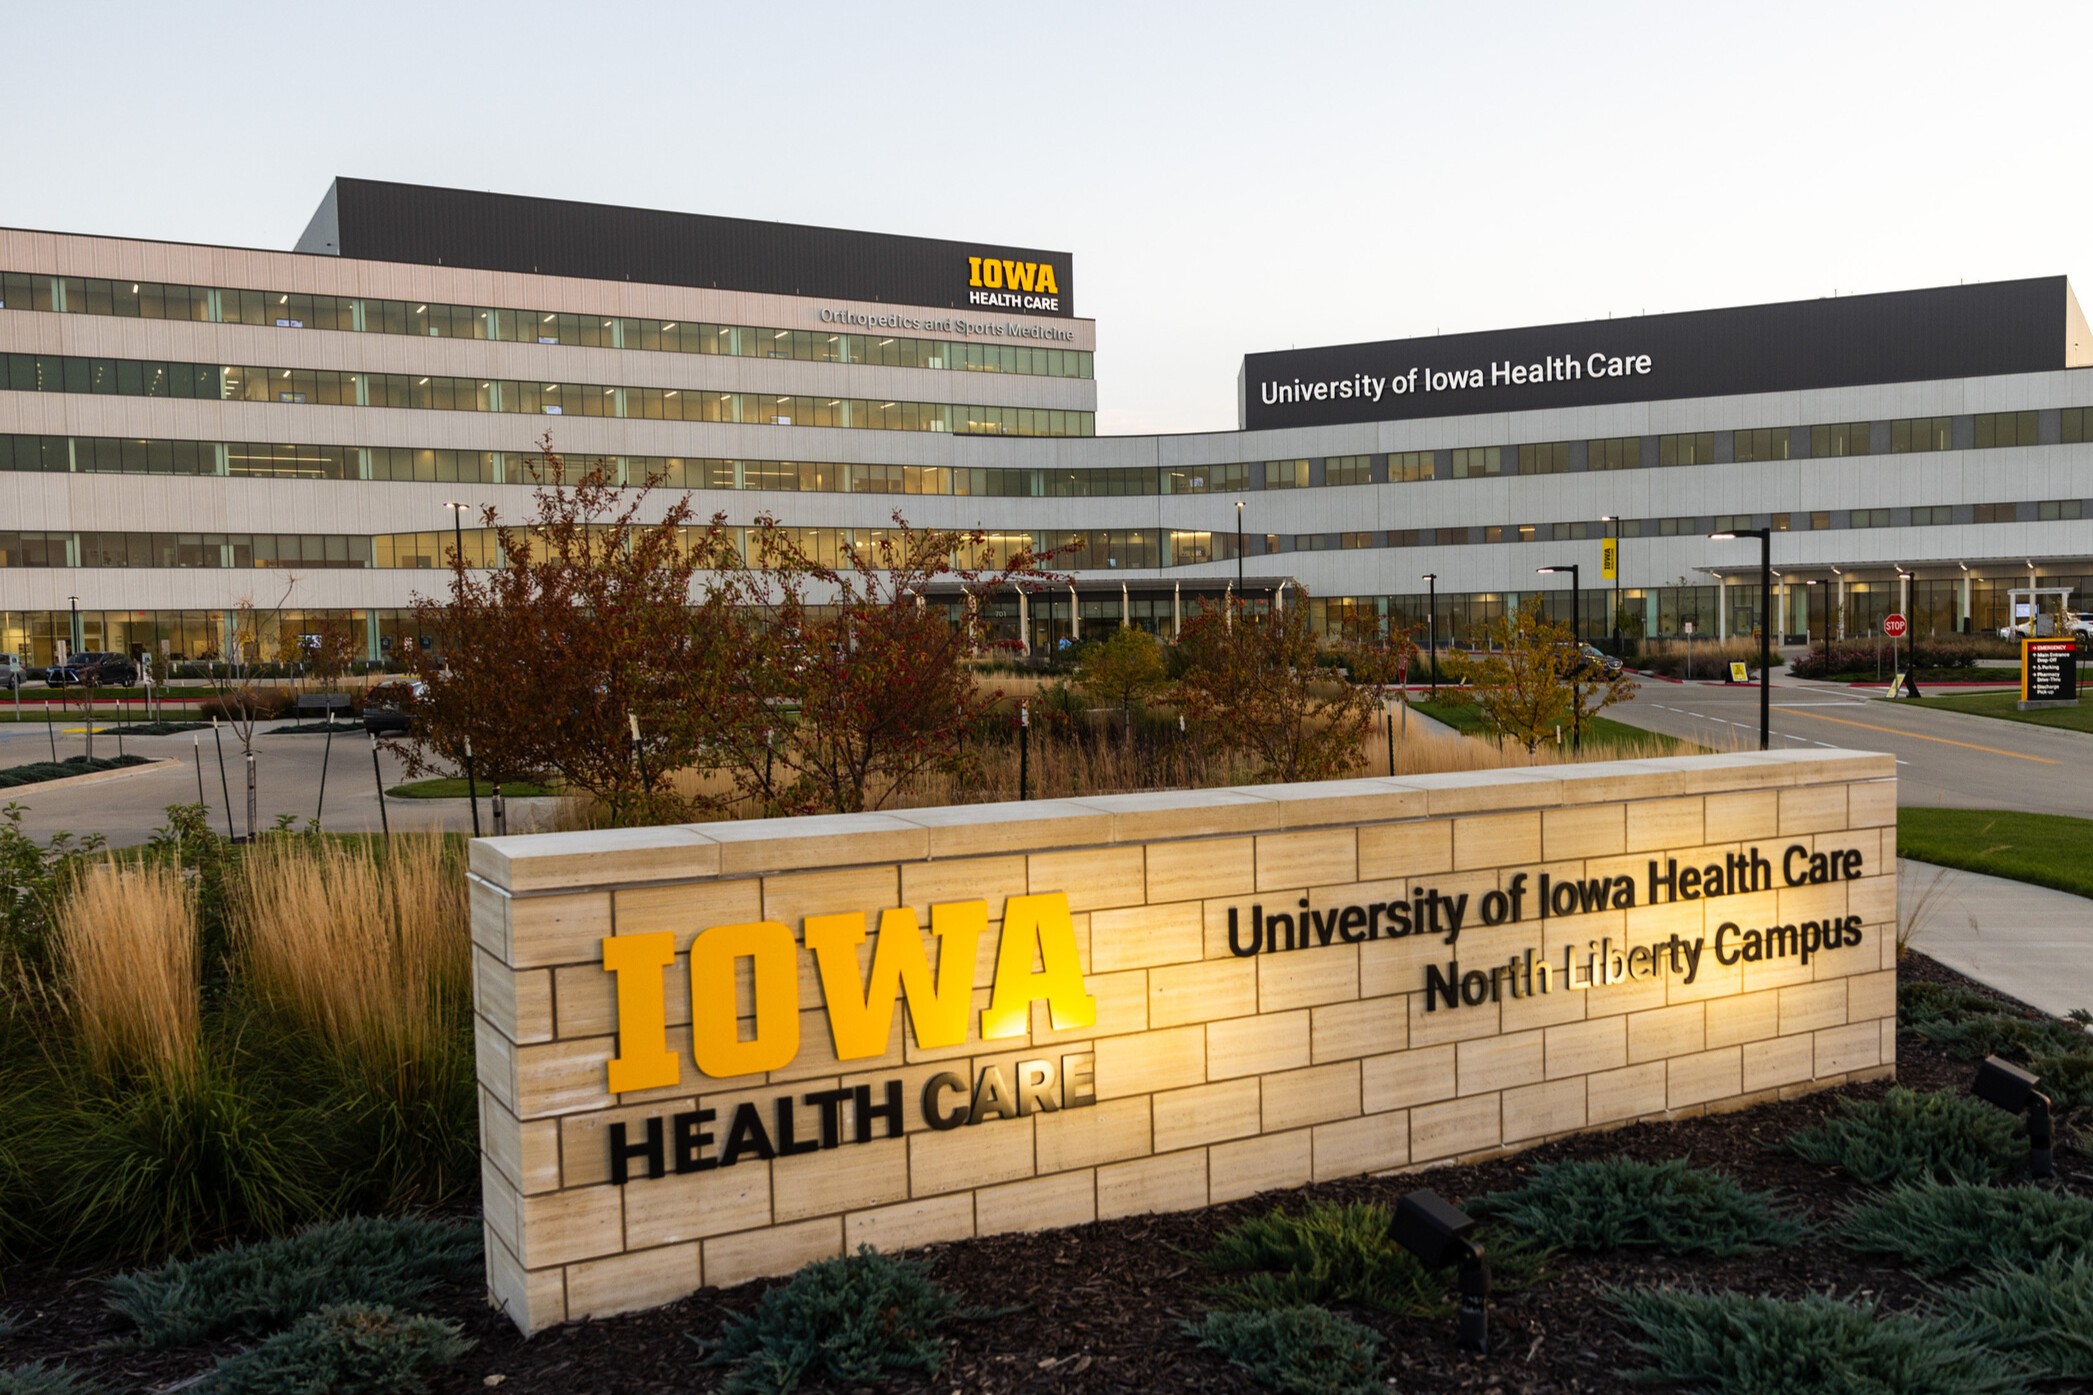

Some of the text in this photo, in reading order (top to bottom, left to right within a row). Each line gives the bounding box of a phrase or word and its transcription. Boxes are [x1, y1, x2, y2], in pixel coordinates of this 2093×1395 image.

[968, 256, 1059, 294] IOWA
[969, 291, 1059, 311] HEALTH CARE
[820, 307, 1075, 341] Orthopedics and Sports Medicine
[1261, 352, 1652, 404] University of Iowa Health Care
[1886, 621, 1905, 631] STOP
[1227, 844, 1863, 958] University of Iowa Health Care
[1425, 914, 1863, 1012] North Liberty Campus
[602, 890, 1096, 1094] IOWA
[608, 1050, 1097, 1185] HEALTH CARE
